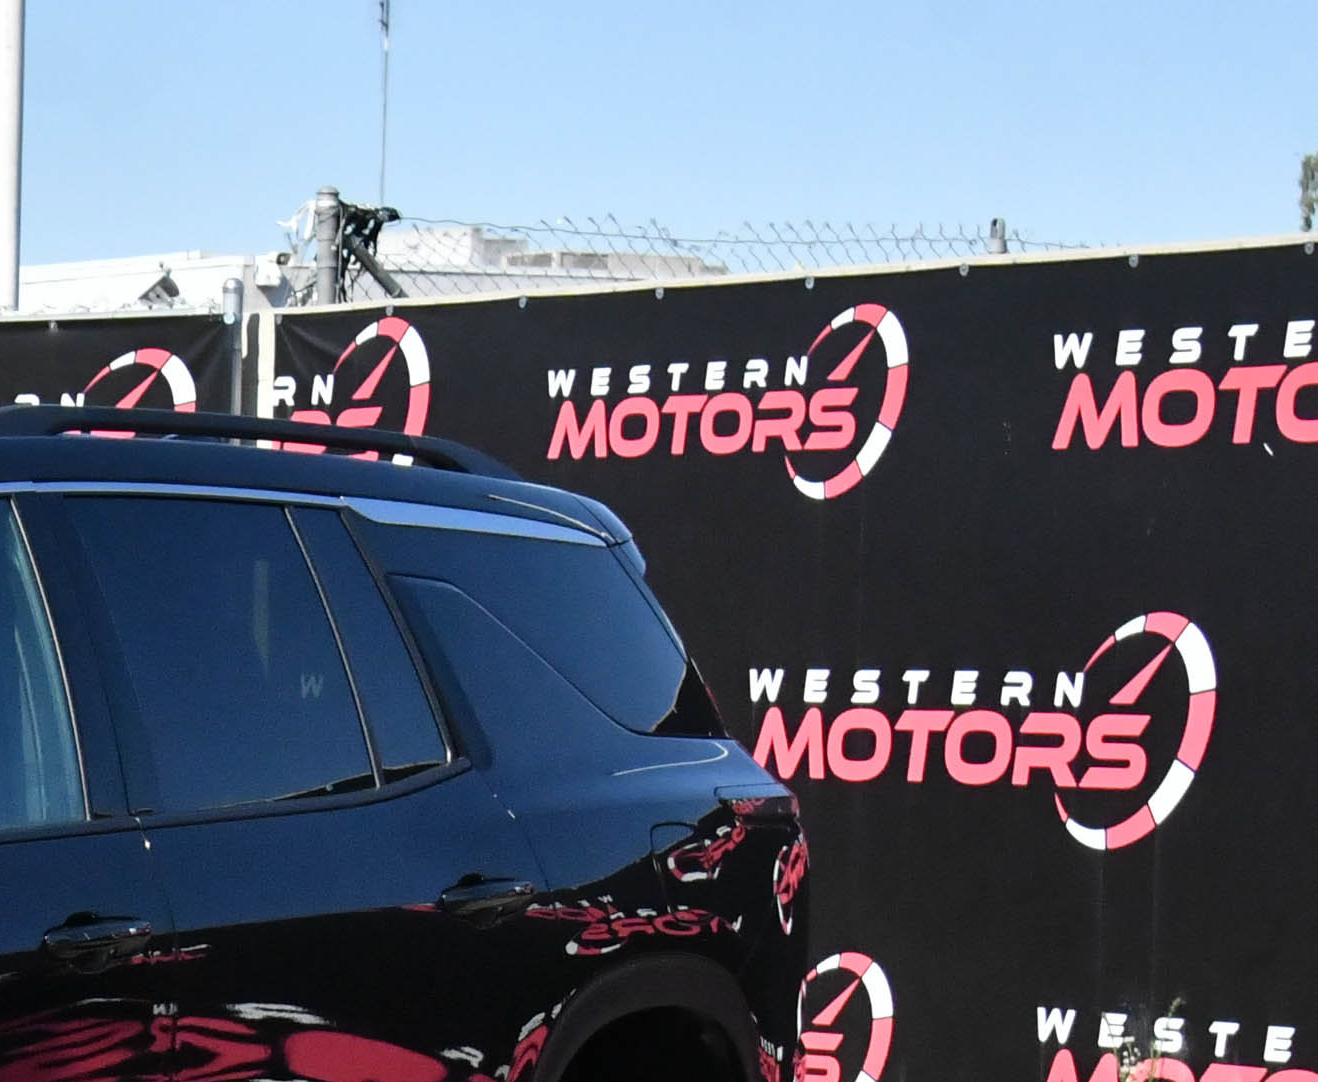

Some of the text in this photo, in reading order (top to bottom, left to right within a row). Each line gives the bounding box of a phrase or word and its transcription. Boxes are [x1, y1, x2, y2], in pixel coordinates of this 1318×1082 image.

[1053, 319, 1316, 370] WESTE
[547, 355, 810, 399] WESTERN
[546, 387, 859, 460] MOTORS
[748, 667, 1085, 708] WESTERN
[752, 706, 1152, 790] MOTORS
[1036, 1006, 1297, 1064] WESTE
